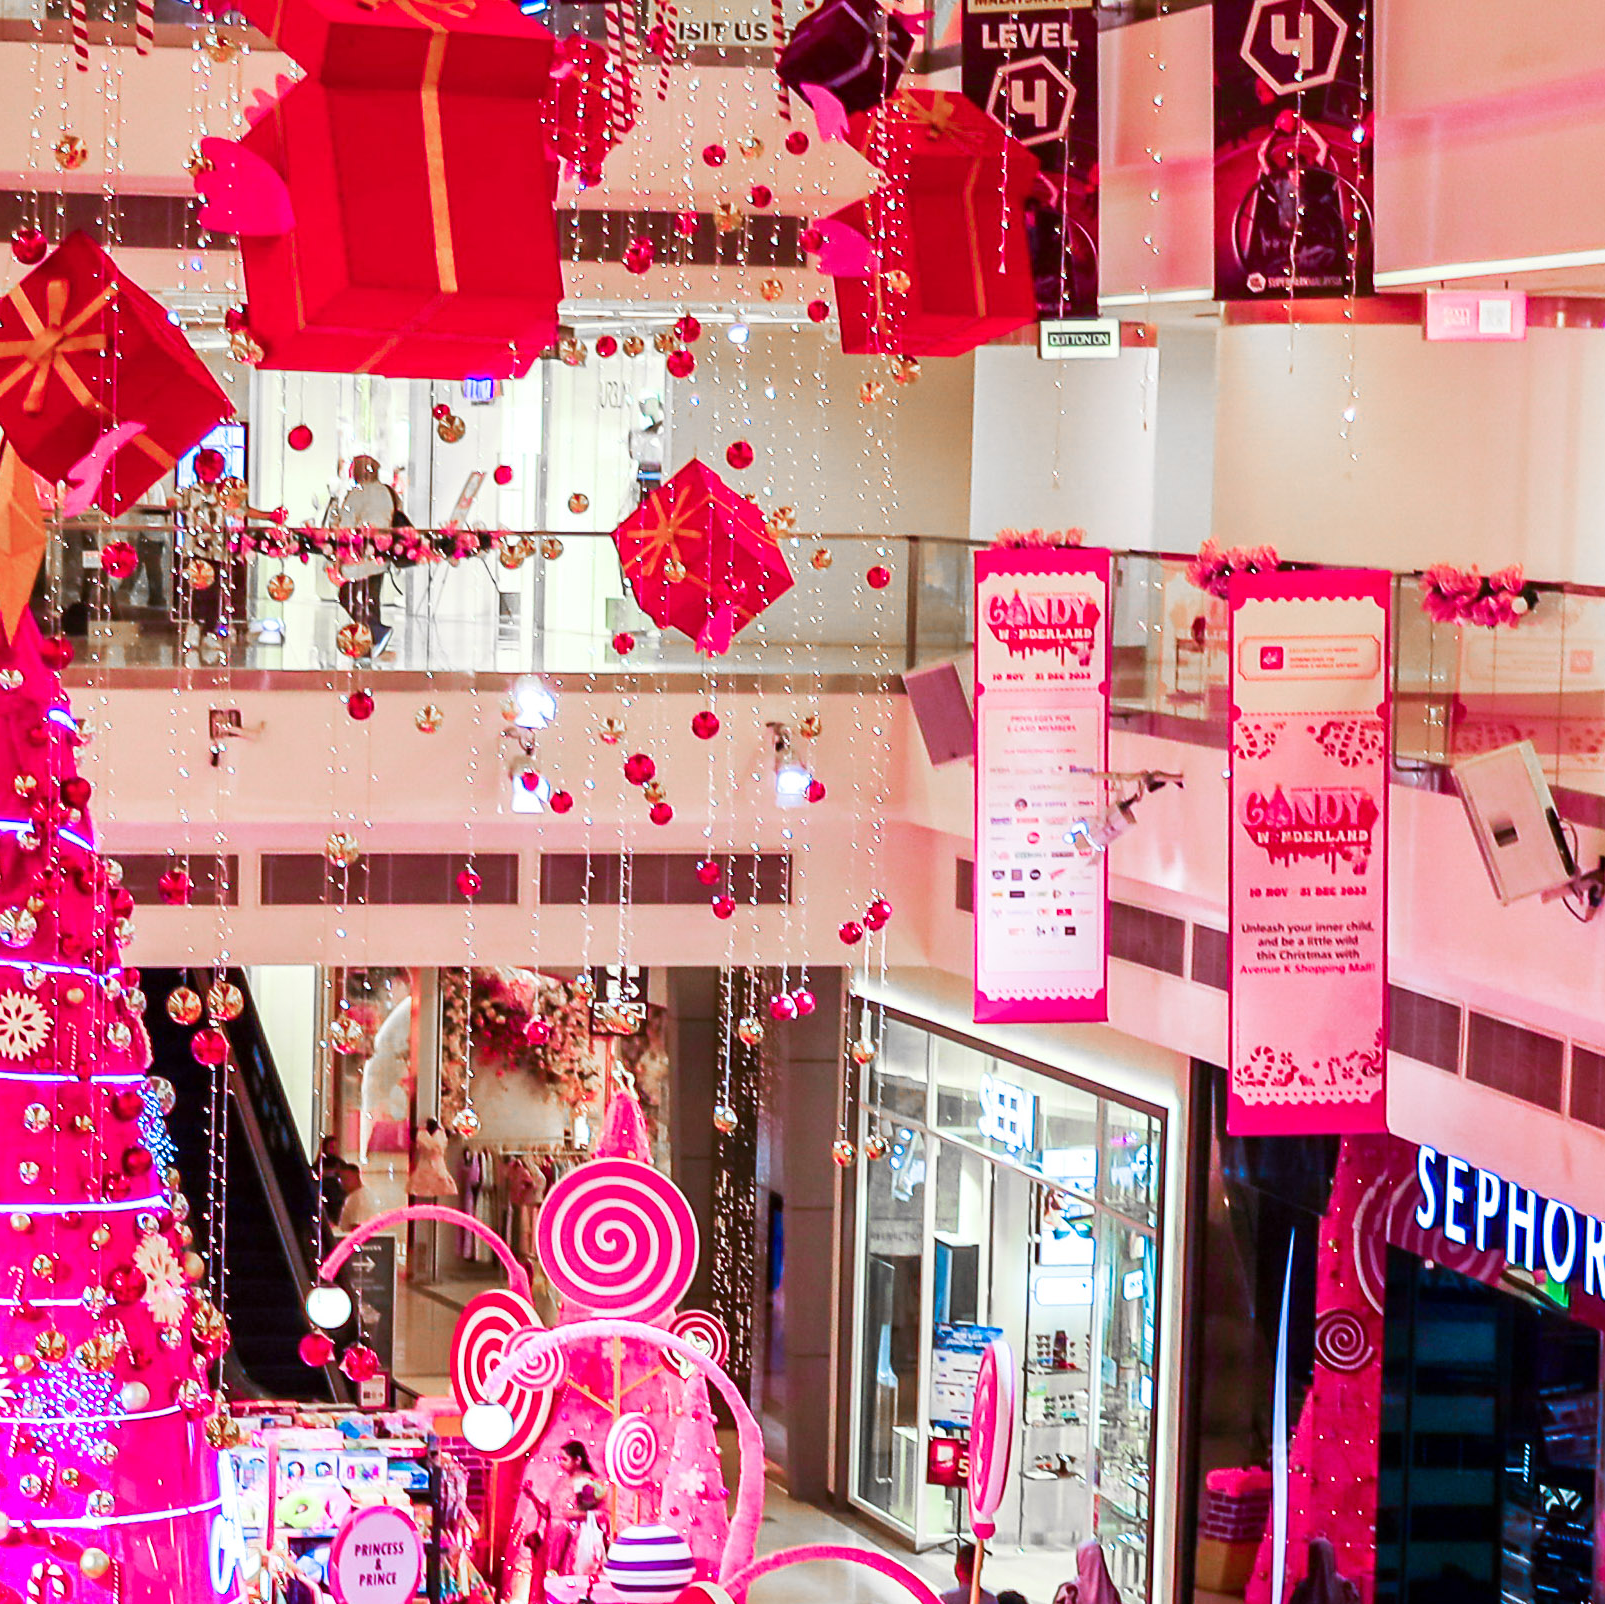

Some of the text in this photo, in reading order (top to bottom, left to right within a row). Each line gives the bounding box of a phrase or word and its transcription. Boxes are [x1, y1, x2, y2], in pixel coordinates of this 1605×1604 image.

[736, 22, 768, 41] US
[981, 23, 1079, 50] LEVEL
[1270, 13, 1314, 72] 4
[1011, 79, 1048, 127] 4
[354, 1541, 405, 1557] PRINCESS
[374, 1558, 383, 1571] &
[359, 1572, 397, 1587] PRINCE
